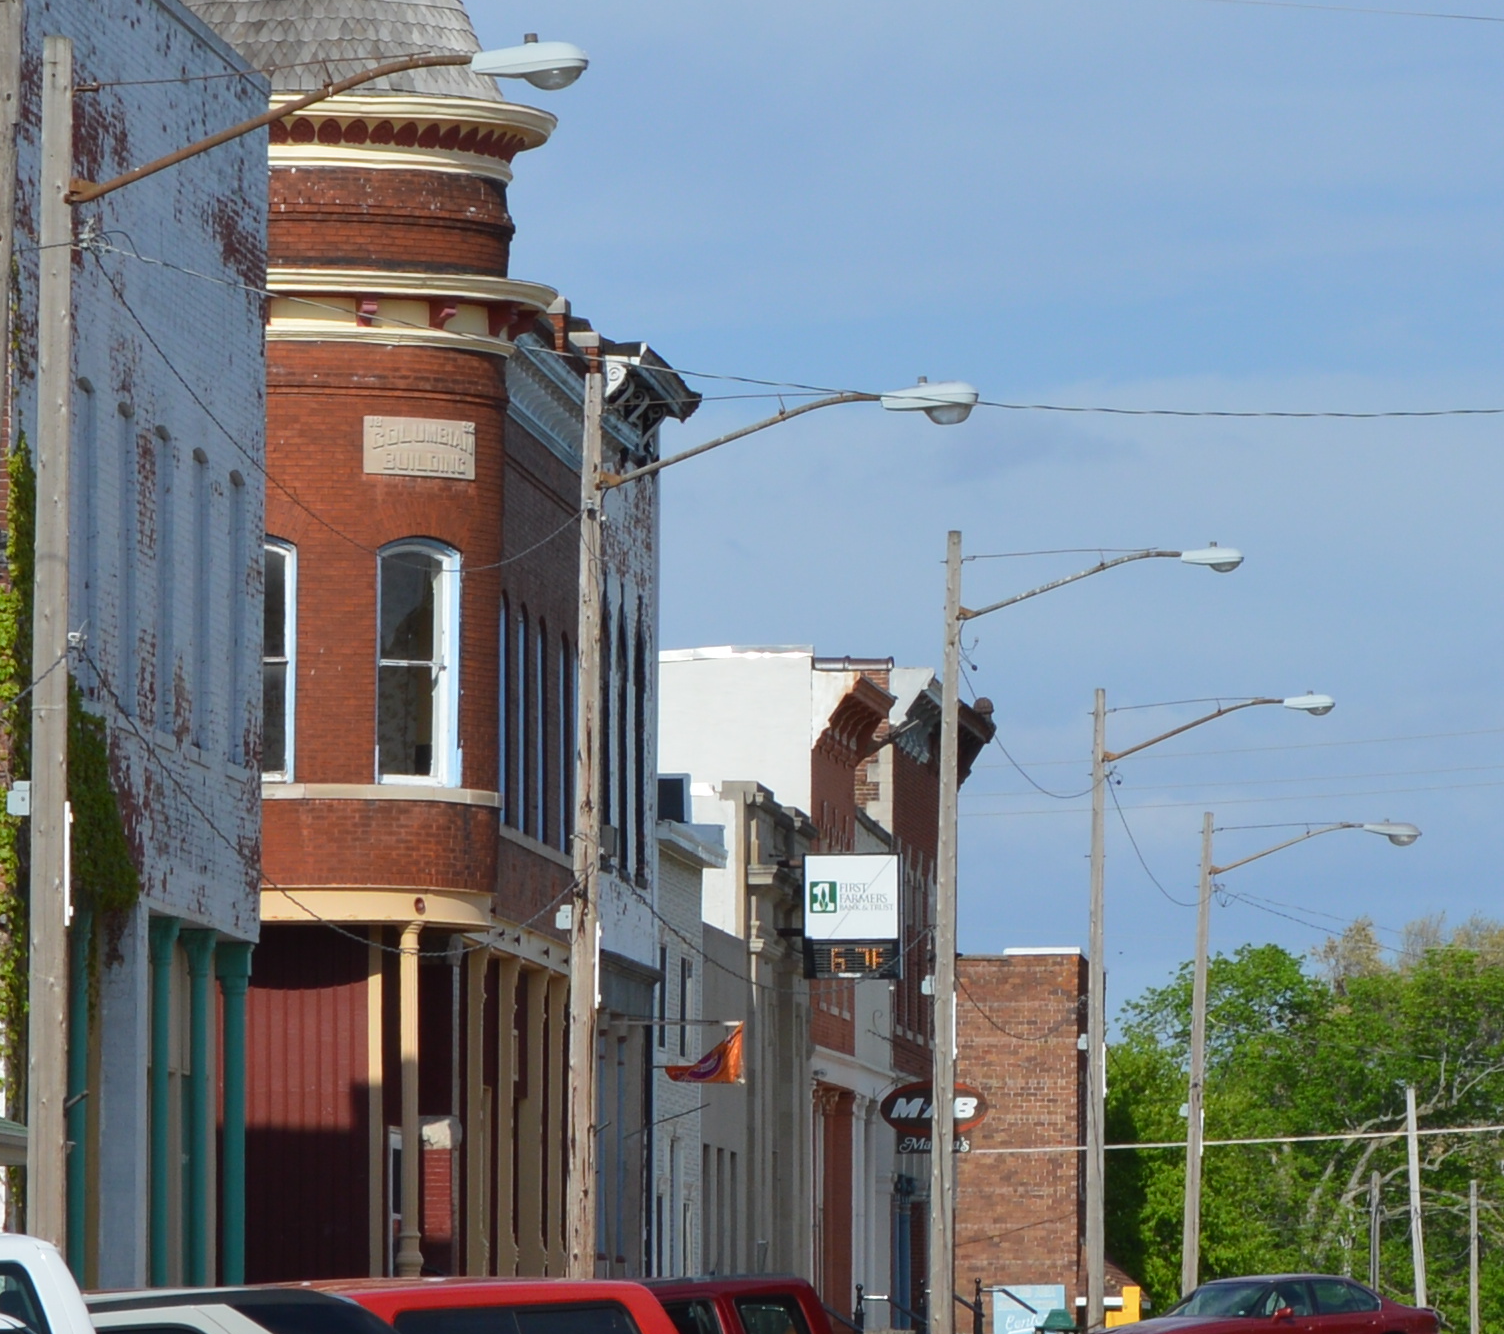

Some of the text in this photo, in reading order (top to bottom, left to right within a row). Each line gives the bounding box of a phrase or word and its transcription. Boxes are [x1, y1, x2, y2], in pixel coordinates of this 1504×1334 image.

[372, 423, 475, 456] COLUMBIAN
[383, 453, 467, 475] BUILDING
[839, 883, 868, 893] FIRST
[839, 893, 888, 903] FARMERS
[870, 903, 894, 911] TRUST
